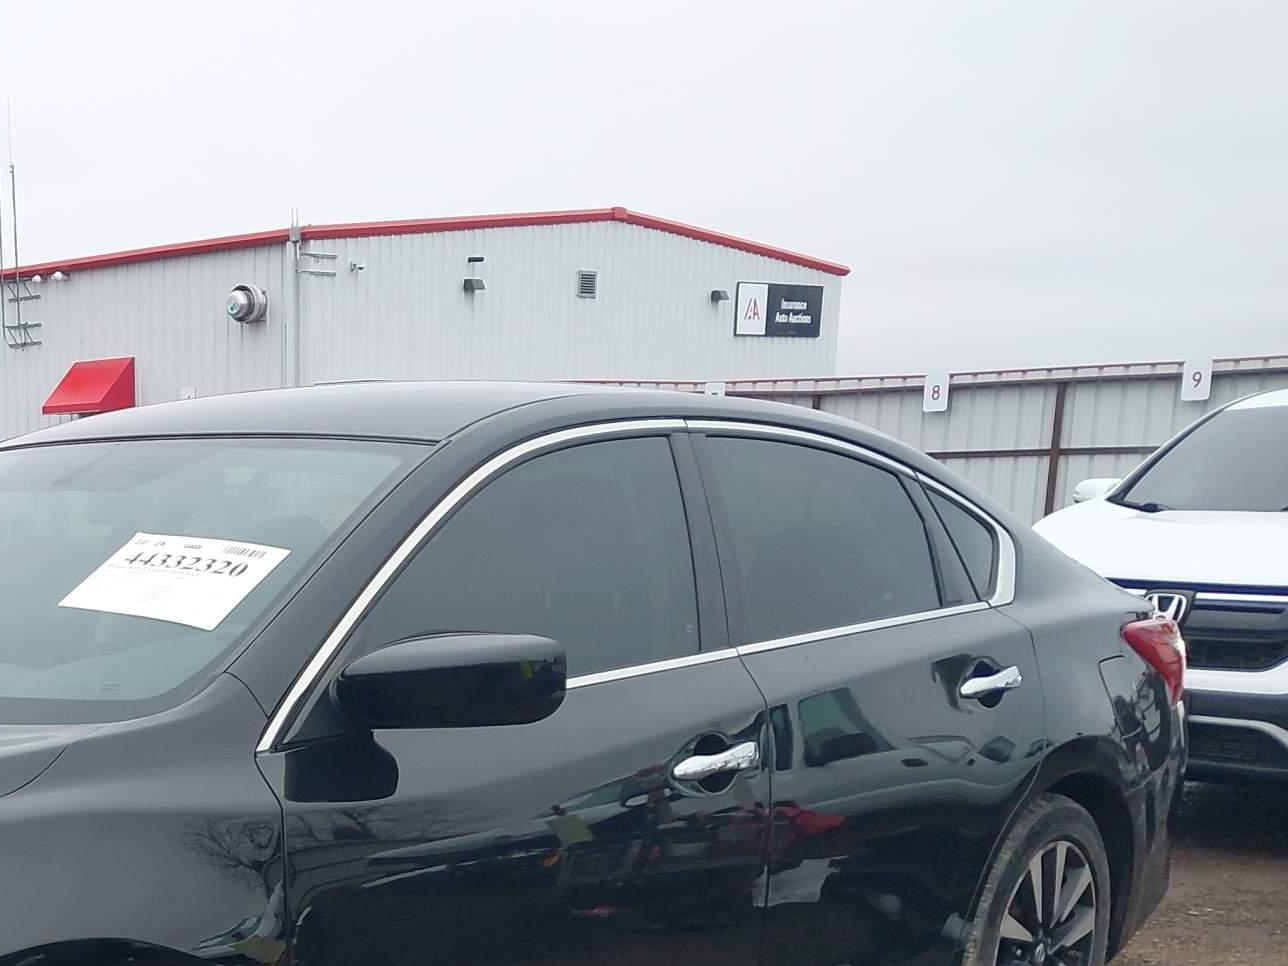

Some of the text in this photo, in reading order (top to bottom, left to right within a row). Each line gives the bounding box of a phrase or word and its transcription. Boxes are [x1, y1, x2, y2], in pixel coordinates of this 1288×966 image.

[781, 298, 807, 310] Insurance
[775, 311, 812, 324] Auto Auctions
[1192, 371, 1202, 388] 9
[932, 384, 940, 401] 8
[124, 551, 249, 577] 44332320
